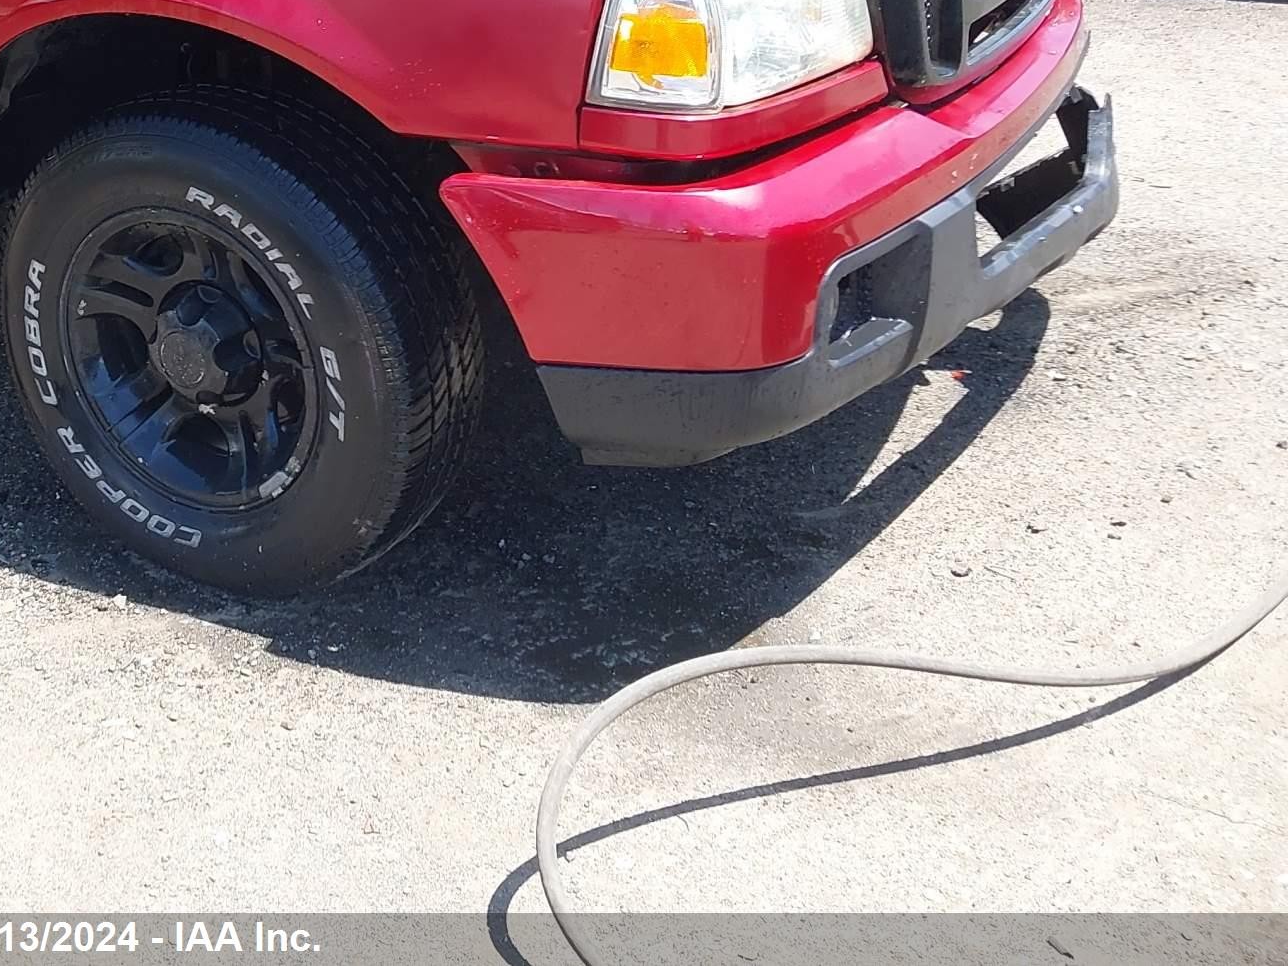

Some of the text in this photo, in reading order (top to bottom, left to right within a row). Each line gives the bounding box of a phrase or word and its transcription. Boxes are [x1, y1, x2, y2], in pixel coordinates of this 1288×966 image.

[23, 258, 203, 548] COOPER COBRA
[185, 185, 345, 442] RADIAL G/T
